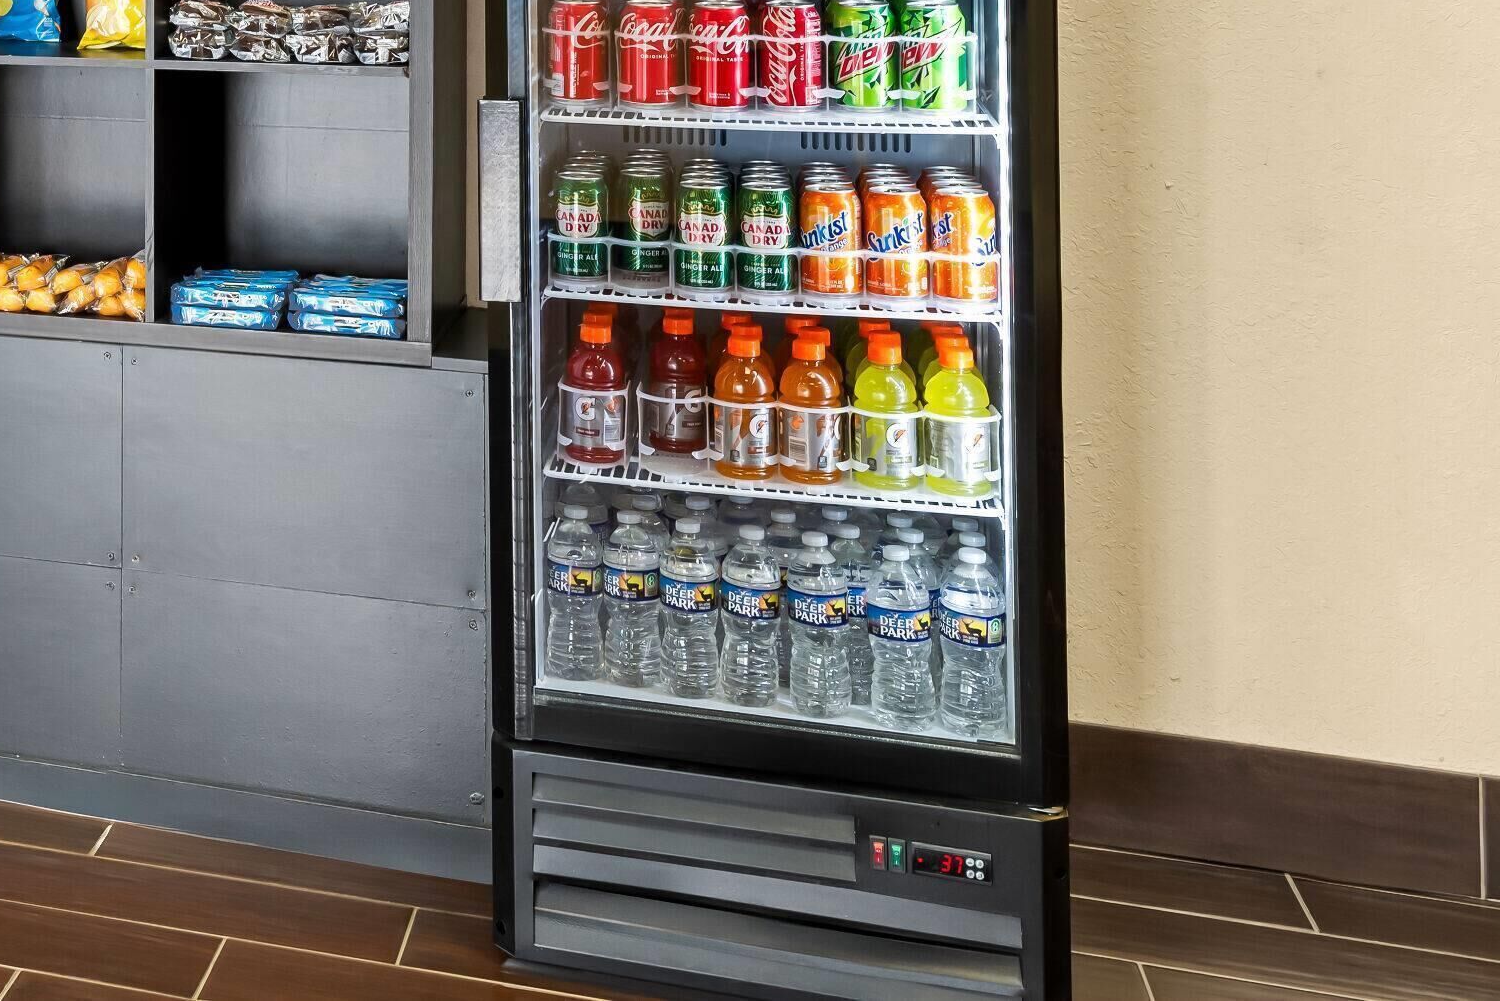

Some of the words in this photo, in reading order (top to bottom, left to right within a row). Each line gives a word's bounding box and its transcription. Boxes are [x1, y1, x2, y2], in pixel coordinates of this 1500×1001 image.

[556, 208, 602, 224] CANADA
[628, 207, 667, 219] CANAD
[565, 223, 590, 233] DRY
[642, 220, 664, 230] DRY
[678, 219, 727, 233] CANADA
[741, 221, 791, 235] CANADA
[689, 233, 715, 244] DRY
[752, 235, 779, 246] DRY
[557, 252, 584, 260] GINGER
[631, 249, 660, 257] GINGER
[680, 262, 708, 271] GINGER
[710, 264, 724, 272] ALE
[744, 265, 773, 274] GINGER
[549, 569, 568, 583] EER
[549, 578, 569, 592] ARK
[604, 581, 621, 596] ARK
[665, 585, 695, 599] DEER
[665, 594, 697, 610] PARK
[728, 591, 759, 607] DEER
[795, 598, 827, 613] DEER
[848, 595, 865, 605] ER
[728, 602, 760, 618] PARK
[795, 609, 828, 625] PARK
[848, 604, 865, 616] RK
[880, 615, 915, 630] DEER
[880, 626, 916, 641] PARK
[939, 854, 965, 874] 37
